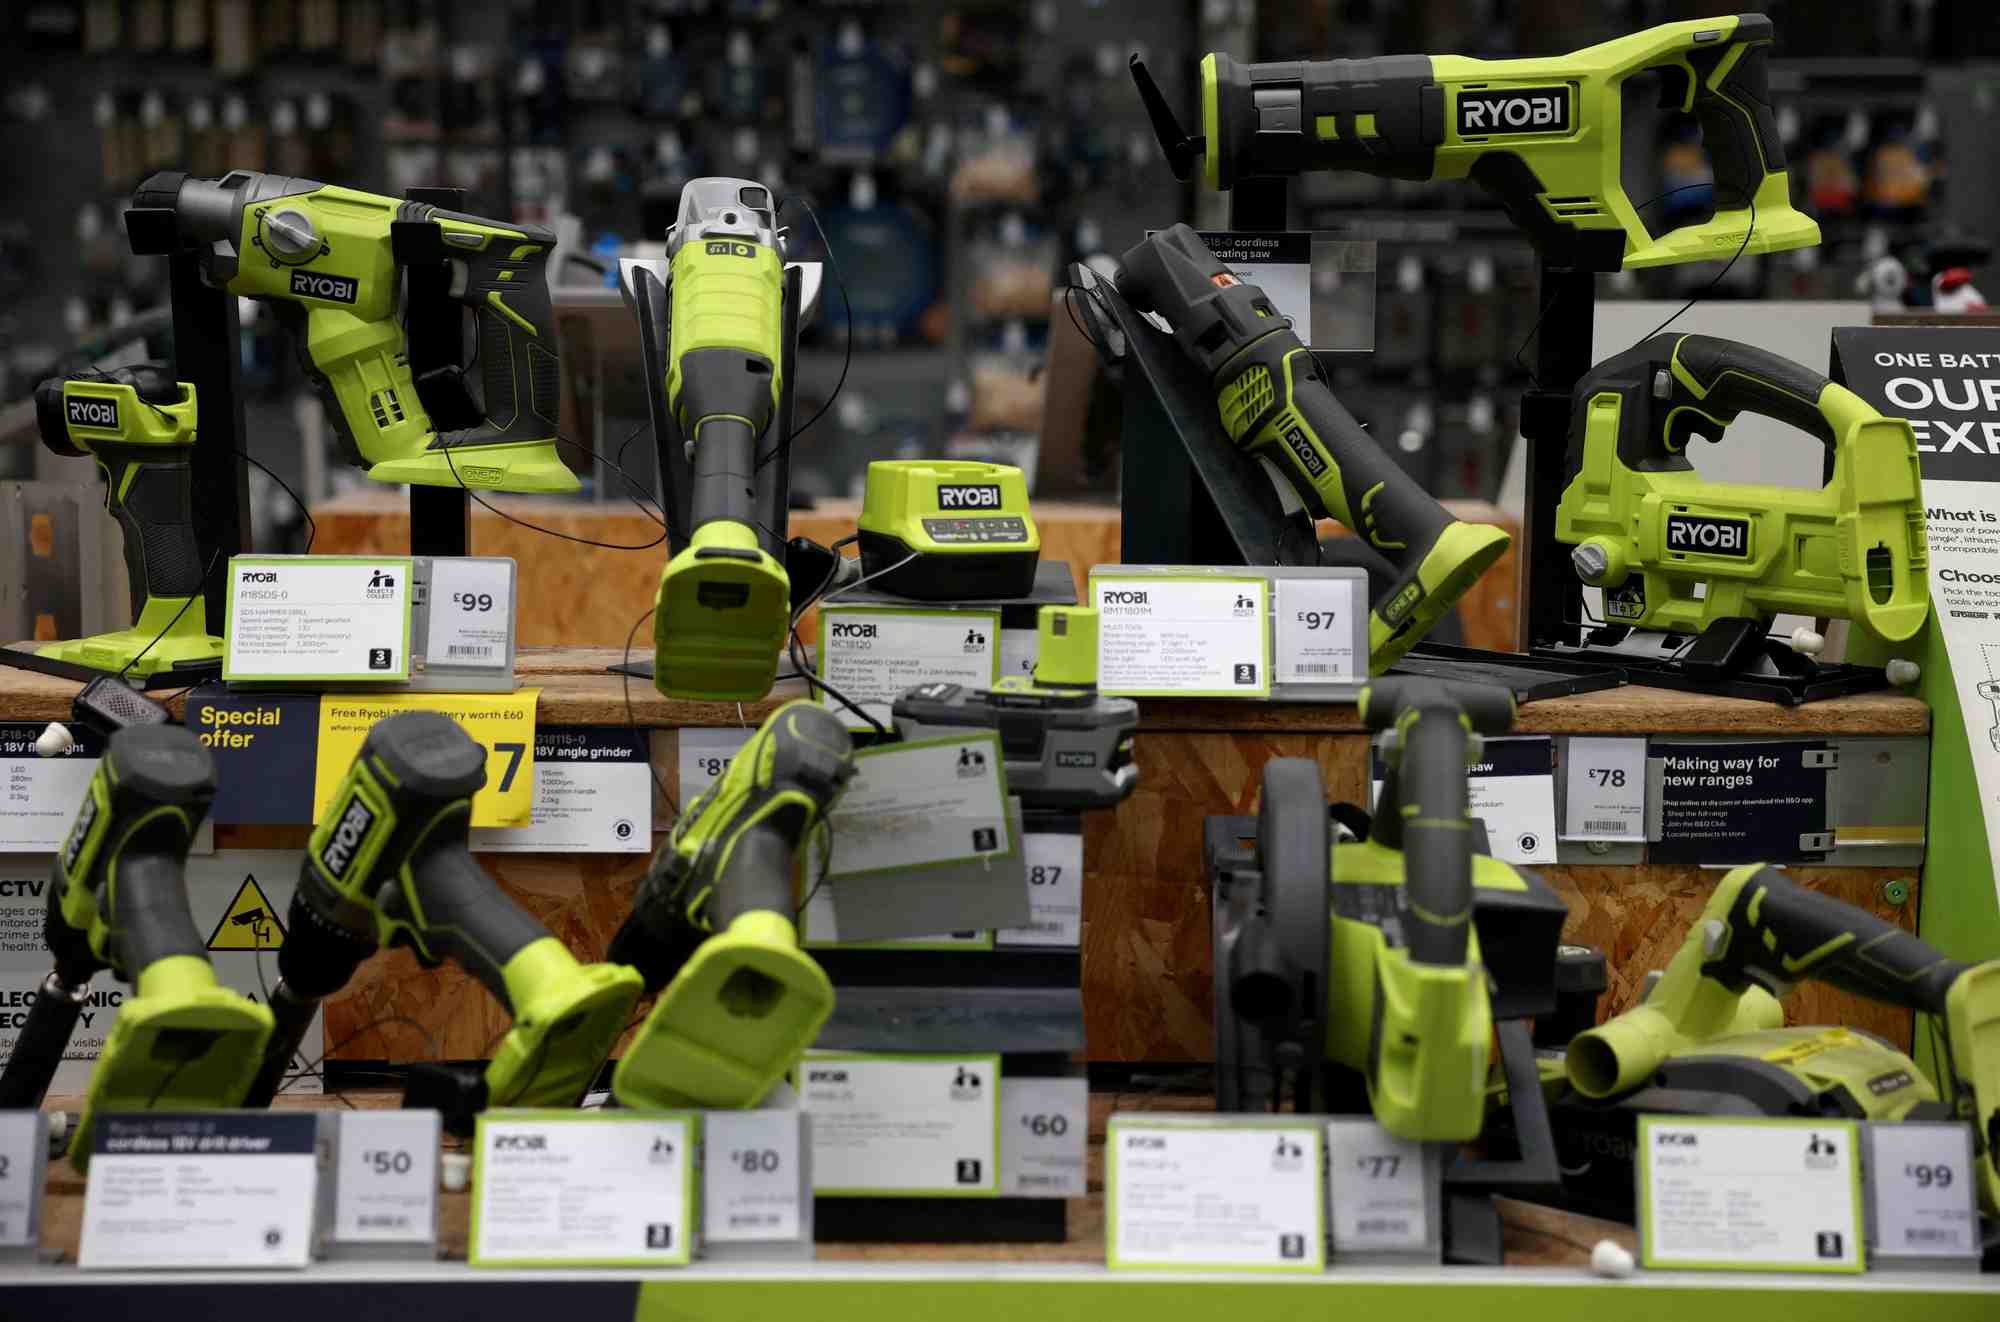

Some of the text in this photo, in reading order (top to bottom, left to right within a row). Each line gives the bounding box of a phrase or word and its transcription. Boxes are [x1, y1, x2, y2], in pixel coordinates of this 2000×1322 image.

[1463, 96, 1561, 129] RYOBI
[1235, 239, 1279, 247] cordless
[293, 273, 354, 301] RYOBI
[1874, 352, 1933, 368] ONE
[69, 401, 116, 424] RYOBI
[1289, 429, 1324, 475] RYOBI
[941, 487, 998, 506] RYOBI
[1925, 507, 1997, 522] What is
[1671, 521, 1742, 549] RYOBI
[1935, 525, 1964, 534] range
[1942, 545, 1998, 554] compatible
[242, 572, 278, 583] RYOBI
[240, 591, 288, 600] R18SDS-0
[1103, 591, 1149, 604] RYOBI
[1966, 588, 1982, 596] the
[453, 593, 493, 612] £99
[1946, 598, 1970, 606] tools
[1298, 612, 1335, 630] £97
[832, 623, 877, 637] RYOBI
[832, 640, 872, 649] RC18120
[376, 650, 384, 661] 3
[885, 659, 920, 667] CHARGER
[1240, 665, 1249, 677] 3
[200, 705, 281, 727] Special
[331, 708, 356, 718] Free
[358, 708, 391, 722] Ryobi
[469, 711, 502, 720] worth
[503, 711, 524, 720] £60
[330, 723, 368, 733] when you
[200, 729, 254, 748] offer
[4, 742, 25, 752] 18V
[535, 746, 632, 759] 18V angle grinder
[1059, 753, 1093, 765] RYOBI
[1663, 755, 1780, 773] Making way for
[1467, 763, 1494, 775] saw
[1588, 768, 1626, 787] £78
[1663, 775, 1753, 789] new ranges
[324, 799, 370, 875] RYOBI
[1031, 866, 1062, 885] 87
[0, 880, 44, 897] CTV
[2, 942, 38, 951] health
[0, 991, 122, 1007] LECNIC
[1021, 1114, 1068, 1137] £60
[106, 1136, 170, 1151] cordless
[363, 1151, 412, 1175] £50
[731, 1150, 779, 1172] £80
[1358, 1155, 1401, 1179] £77
[1906, 1164, 1953, 1188] £99
